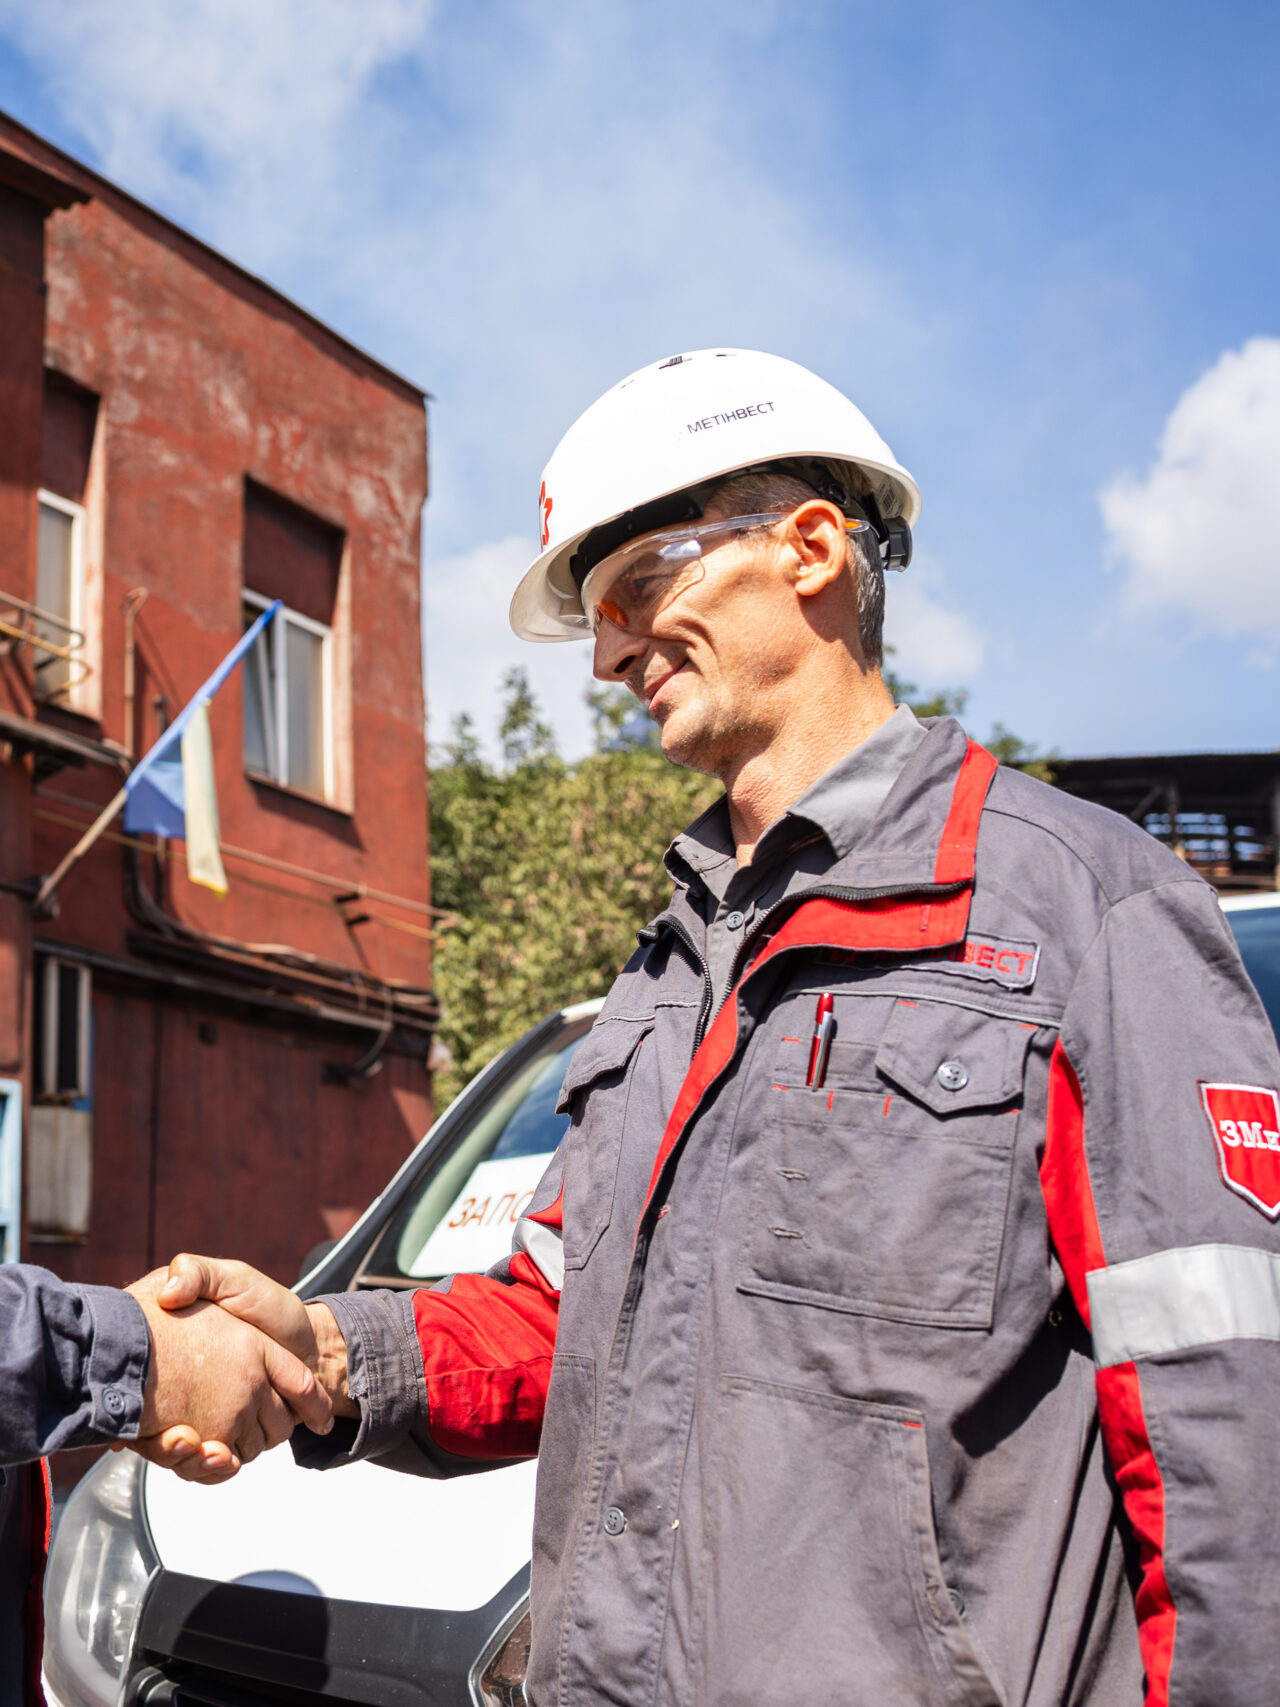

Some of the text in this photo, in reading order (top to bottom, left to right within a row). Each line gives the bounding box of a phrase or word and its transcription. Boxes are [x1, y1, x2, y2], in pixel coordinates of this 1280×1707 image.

[686, 401, 775, 434] МЕТІНВЕСТ
[958, 941, 1034, 976] ВЕСТ
[448, 1190, 535, 1228] ЗАПО
